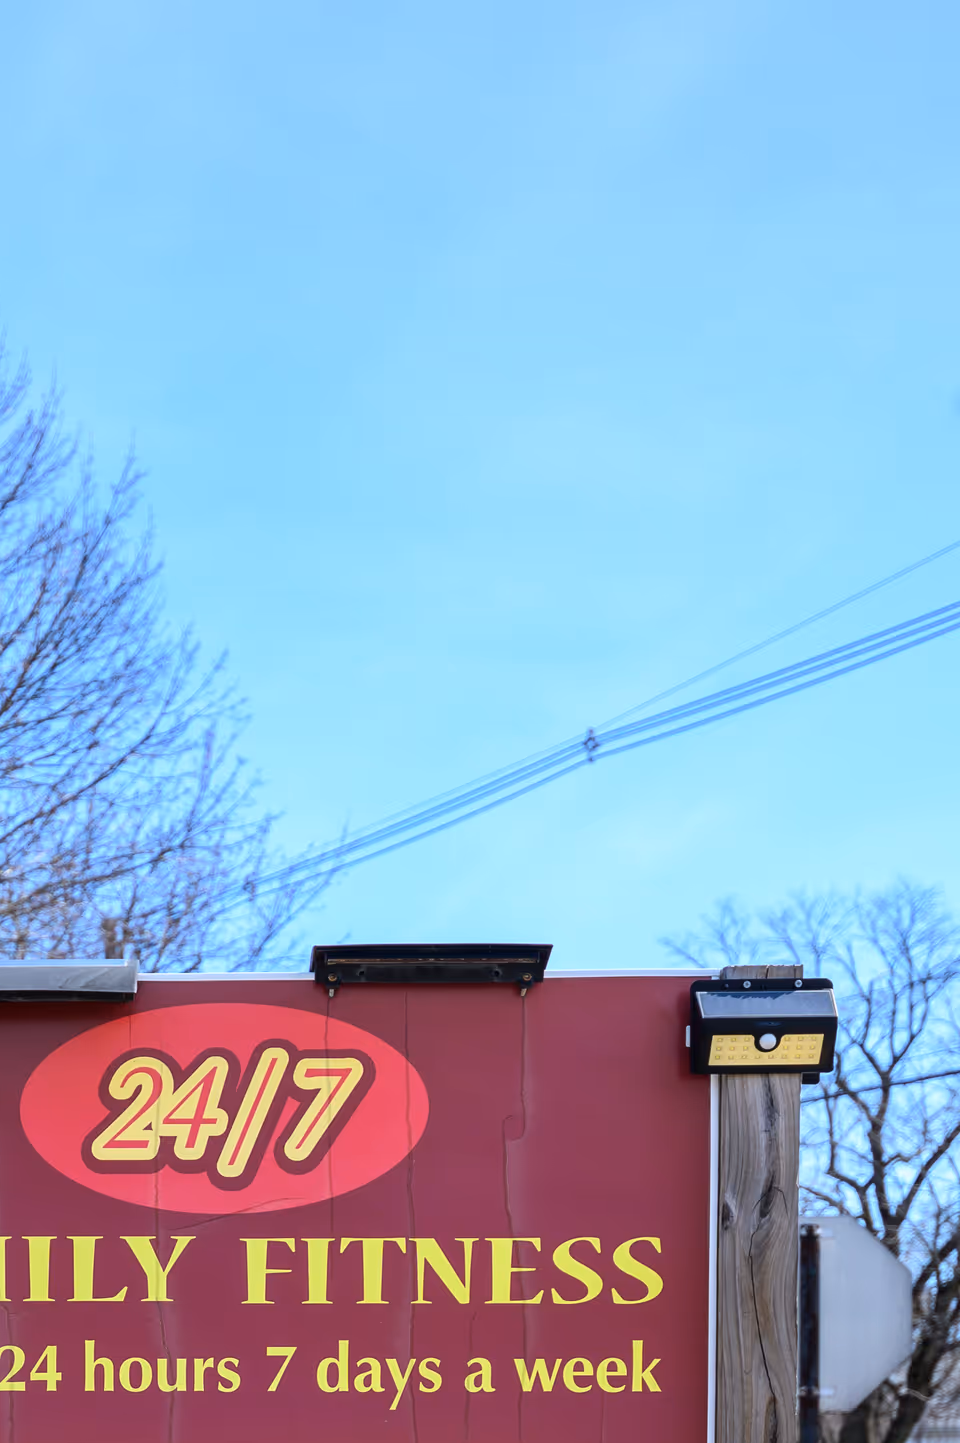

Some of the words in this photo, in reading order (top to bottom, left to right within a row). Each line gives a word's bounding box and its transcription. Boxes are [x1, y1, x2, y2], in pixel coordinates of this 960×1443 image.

[92, 1047, 364, 1178] 24/7
[240, 1237, 664, 1305] FITNESS
[85, 1339, 241, 1393] hours
[266, 1346, 298, 1392] 7
[316, 1339, 442, 1411] days
[465, 1357, 496, 1393] a
[514, 1339, 662, 1394] week
